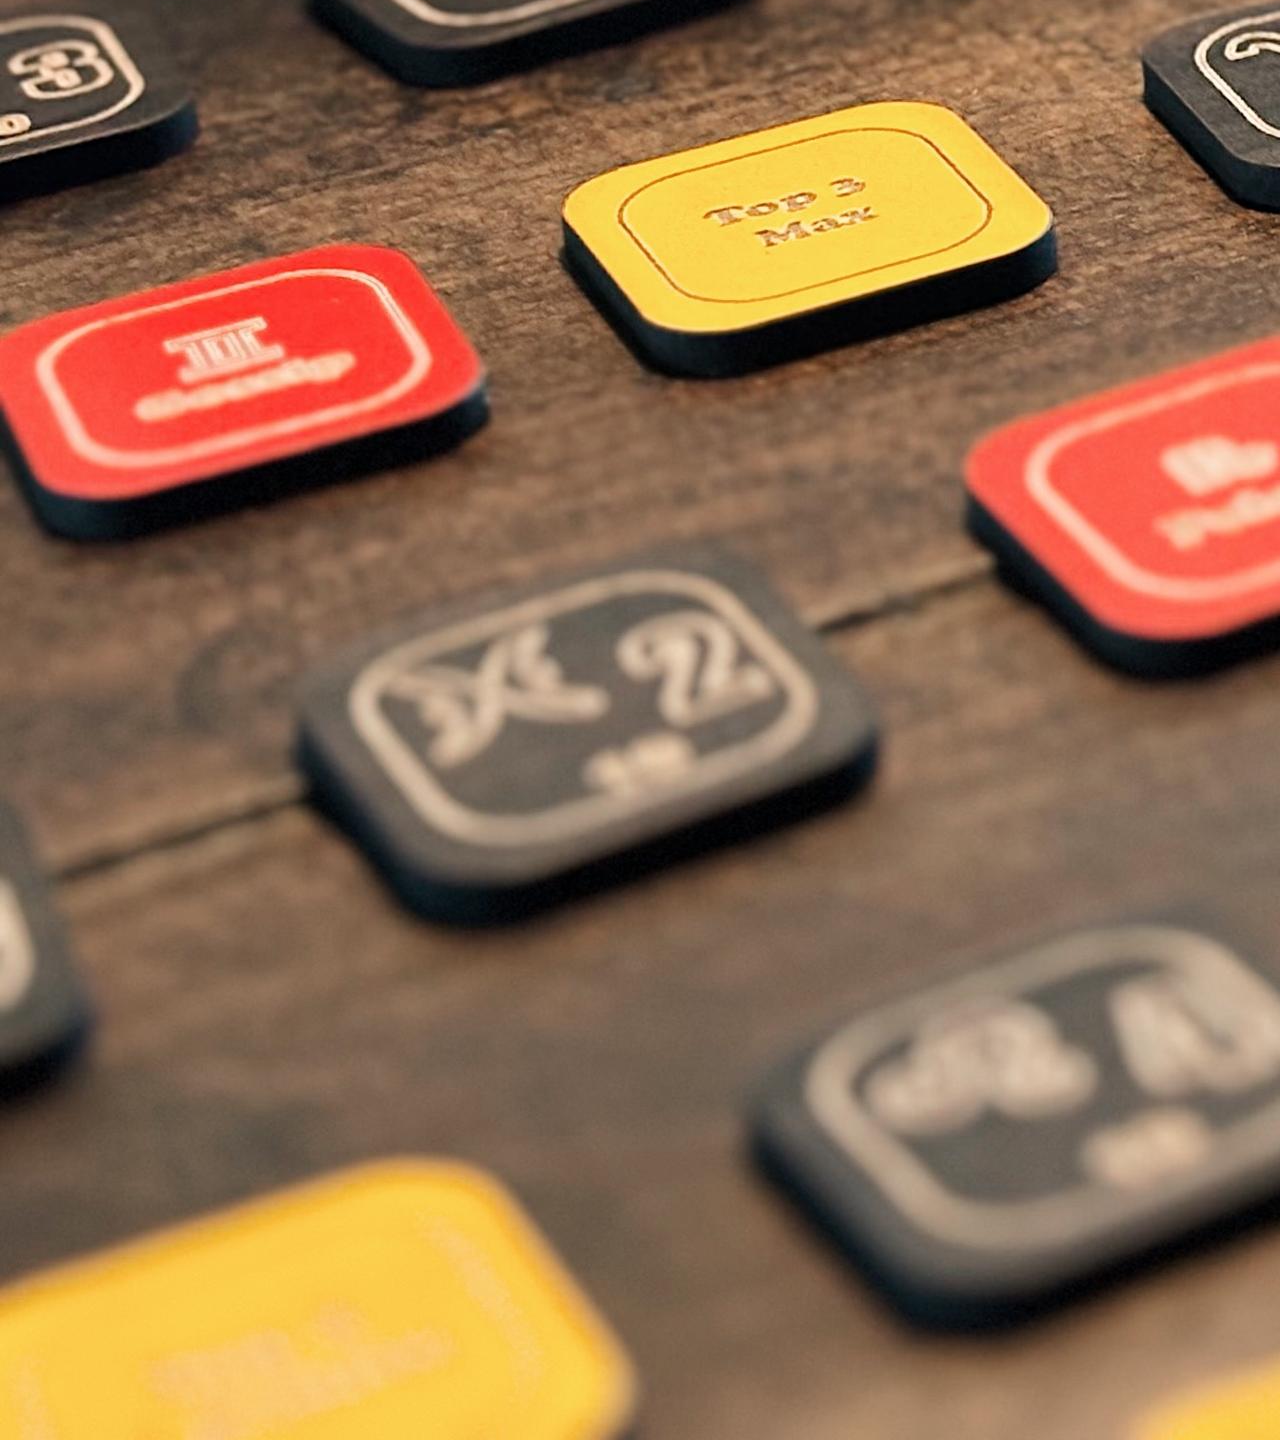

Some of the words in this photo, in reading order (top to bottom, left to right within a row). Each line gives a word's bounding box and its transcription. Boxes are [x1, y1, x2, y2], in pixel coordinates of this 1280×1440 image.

[7, 39, 114, 100] 3
[703, 191, 818, 228] Top
[829, 177, 867, 199] 3
[754, 206, 879, 248] Max
[614, 609, 776, 729] 2
